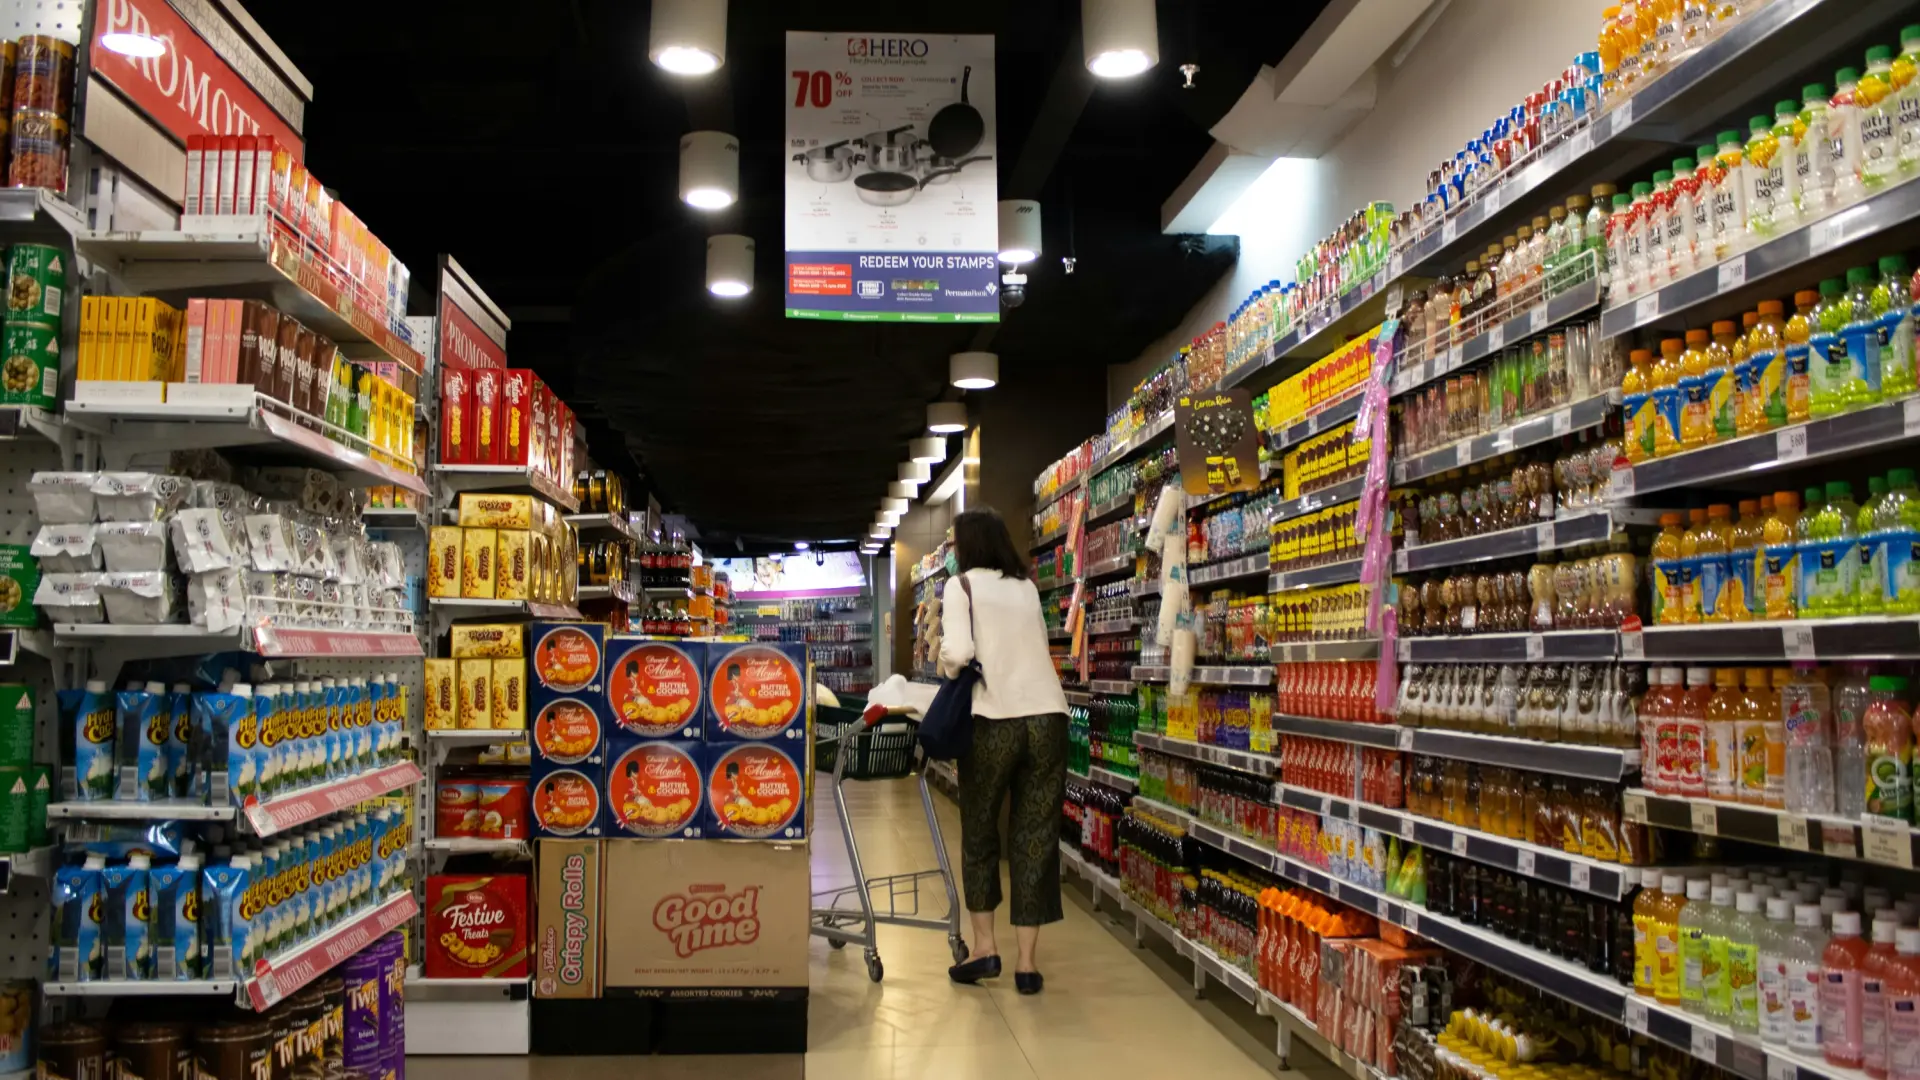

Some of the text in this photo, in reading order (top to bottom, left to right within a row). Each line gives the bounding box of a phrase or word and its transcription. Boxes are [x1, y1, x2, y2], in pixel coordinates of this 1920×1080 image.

[870, 39, 929, 58] HERO
[792, 70, 832, 108] 70
[835, 71, 853, 86] %
[836, 89, 853, 98] OFF
[860, 255, 995, 270] REDEEM YOUR STAMPS
[377, 899, 413, 928] PROMOTION
[442, 903, 505, 930] Festive
[562, 854, 587, 982] Crispy Rolls
[654, 886, 759, 931] Good
[325, 927, 370, 961] PROMOTION
[462, 928, 489, 940] Treats
[670, 918, 760, 958] Time
